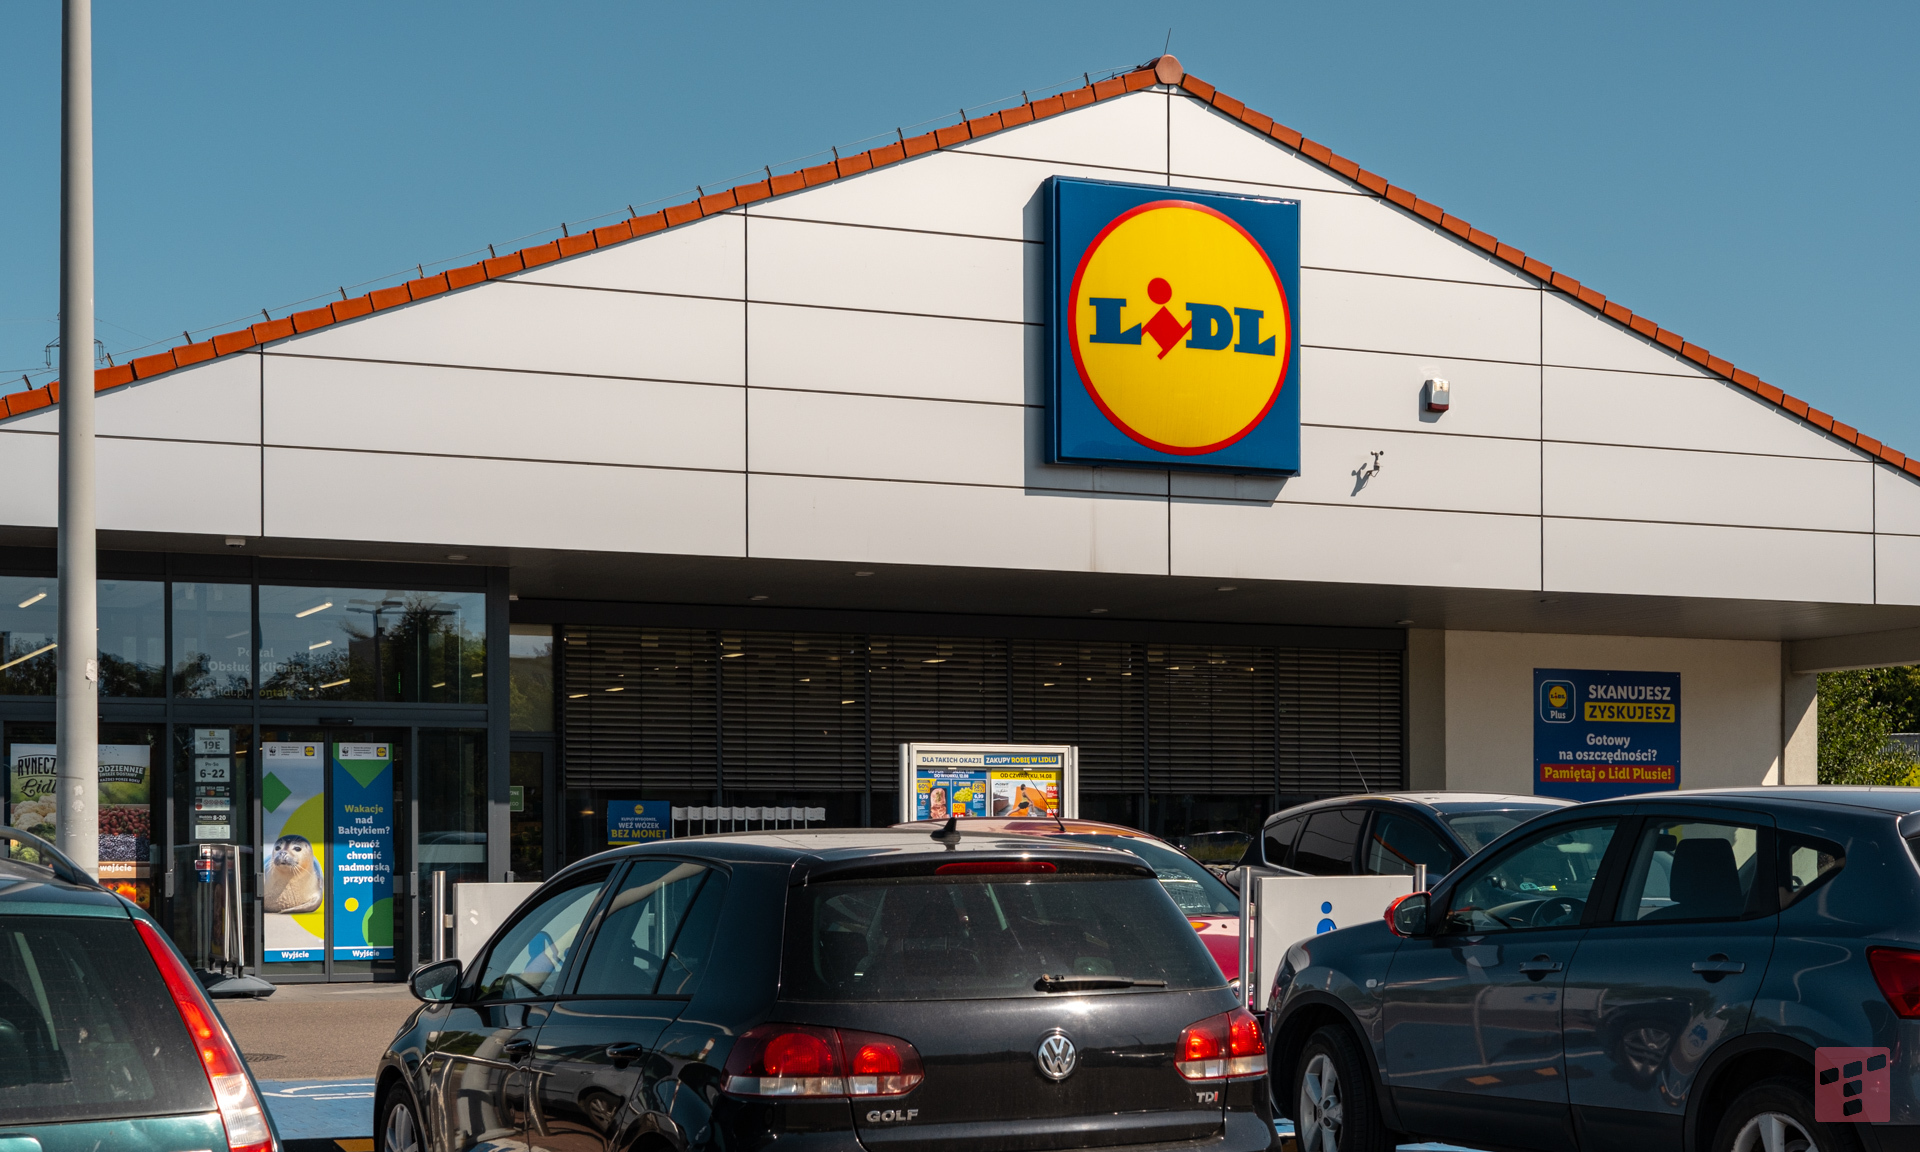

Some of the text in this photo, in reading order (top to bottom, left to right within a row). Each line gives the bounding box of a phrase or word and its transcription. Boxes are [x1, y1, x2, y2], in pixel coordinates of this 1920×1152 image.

[1588, 685, 1671, 701] SKANUJESZ
[1550, 710, 1566, 719] Plus
[1588, 705, 1671, 720] ZYSKUJESZ
[203, 741, 221, 750] 19E
[1586, 733, 1631, 748] Gotowy
[985, 756, 1011, 764] ZAKUPY
[1011, 756, 1030, 764] ROBIĘ
[1559, 749, 1657, 763] na oszczędności?
[98, 765, 144, 774] ODZIENNIE
[200, 769, 225, 778] 6-22
[1544, 766, 1671, 782] Pamiętaj o Lidl Plusie!
[344, 804, 384, 815] Wakacje
[355, 815, 373, 824] nad
[618, 821, 660, 829] WEŹ WÓZEK
[338, 826, 390, 837] Bałtykiem?
[611, 829, 667, 840] BEZ MONET
[348, 839, 380, 849] Pomóż
[346, 850, 382, 860] chronić
[100, 864, 132, 873] wejście
[338, 862, 390, 873] nadmorską
[343, 874, 386, 885] przyrodę
[281, 950, 309, 959] Wyjście
[352, 950, 380, 958] Wyjście
[1196, 1091, 1219, 1104] TDI
[866, 1108, 919, 1123] GOLF
